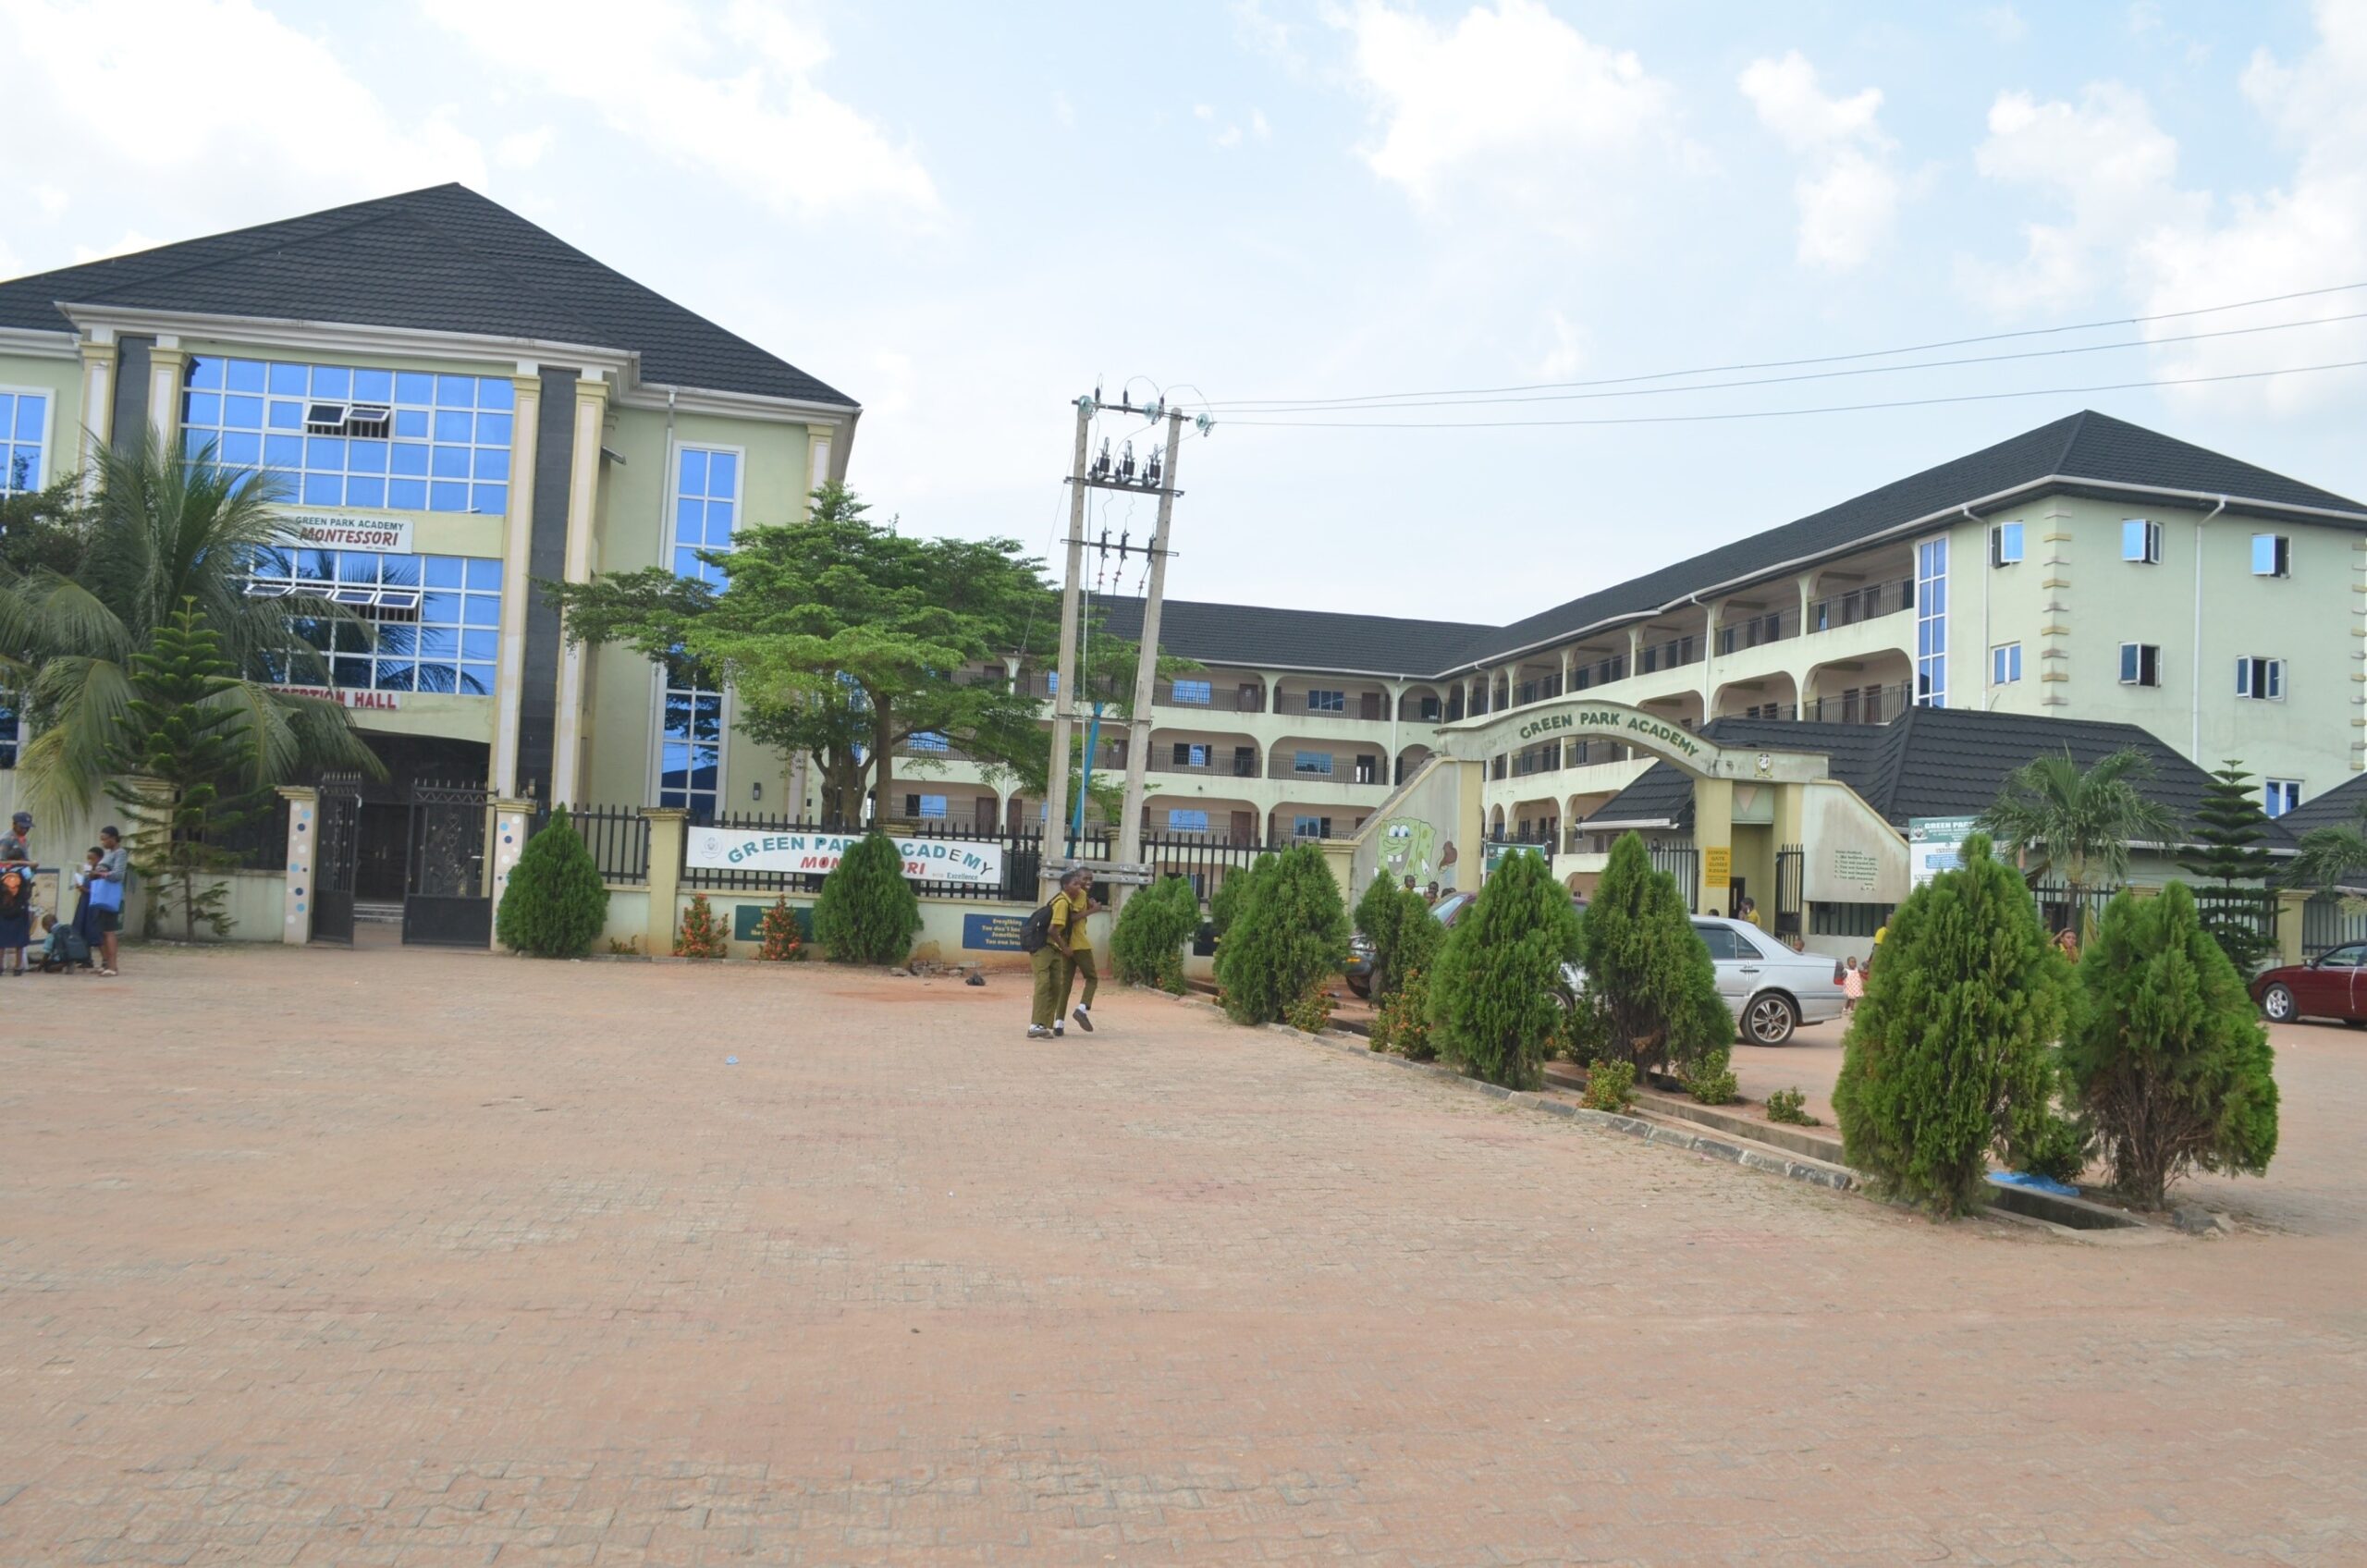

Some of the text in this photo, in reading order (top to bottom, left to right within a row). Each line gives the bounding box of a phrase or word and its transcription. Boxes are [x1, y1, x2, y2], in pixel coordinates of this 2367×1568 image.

[296, 516, 404, 531] GREEN PARK ACADEMY
[300, 527, 399, 545] MONTESSORI
[354, 692, 397, 710] HALL
[1519, 711, 1699, 757] GREEN PARK ACADEMY
[728, 837, 804, 863] GREEN
[901, 842, 993, 876] CADEMY
